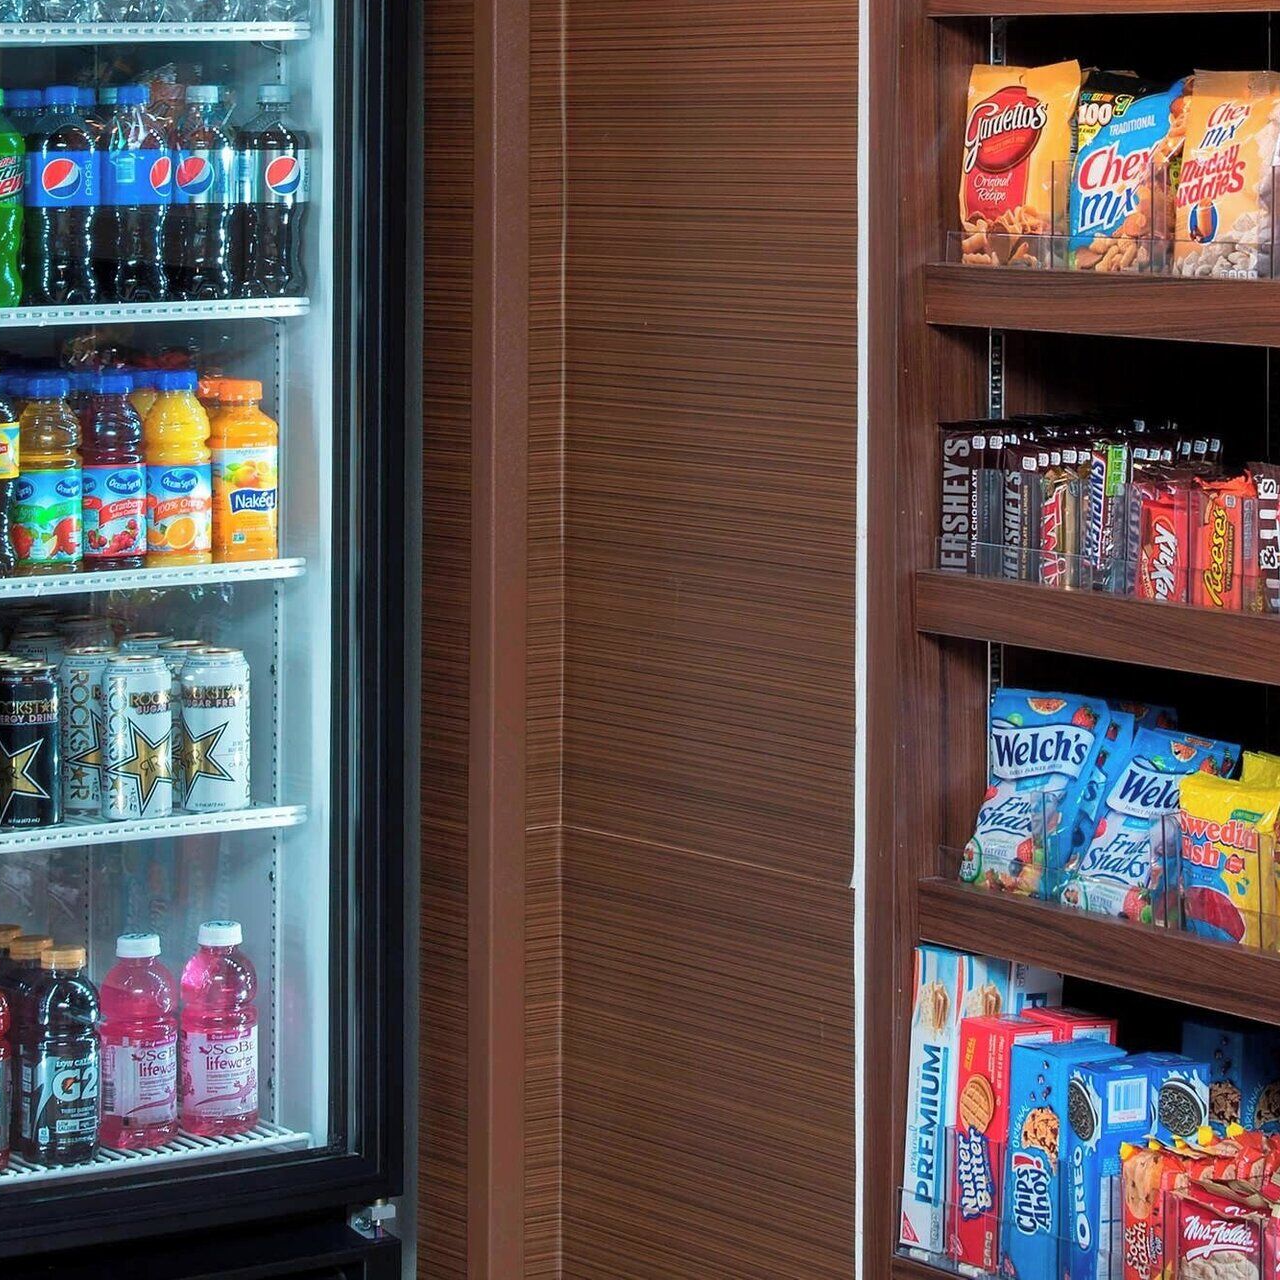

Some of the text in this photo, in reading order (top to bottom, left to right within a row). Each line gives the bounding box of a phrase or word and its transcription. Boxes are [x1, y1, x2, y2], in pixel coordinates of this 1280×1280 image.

[1109, 114, 1157, 136] TRADITIONAL
[85, 160, 93, 196] pepsi
[973, 173, 1013, 194] Original
[977, 187, 1007, 203] Recipe
[157, 501, 179, 515] 100%
[235, 491, 274, 509] Naked
[970, 533, 978, 559] MILK
[1203, 504, 1228, 607] Reese's
[992, 731, 1088, 767] Welch's
[1119, 770, 1181, 809] Welc
[1104, 833, 1150, 854] Fruit
[1081, 847, 1149, 877] Snacks
[53, 1066, 98, 1102] G2
[915, 1043, 941, 1205] PREMIUM
[958, 1134, 978, 1217] Nutter
[968, 1128, 994, 1209] Butter
[1013, 1167, 1037, 1235] Chips
[1074, 1145, 1092, 1251] OREO
